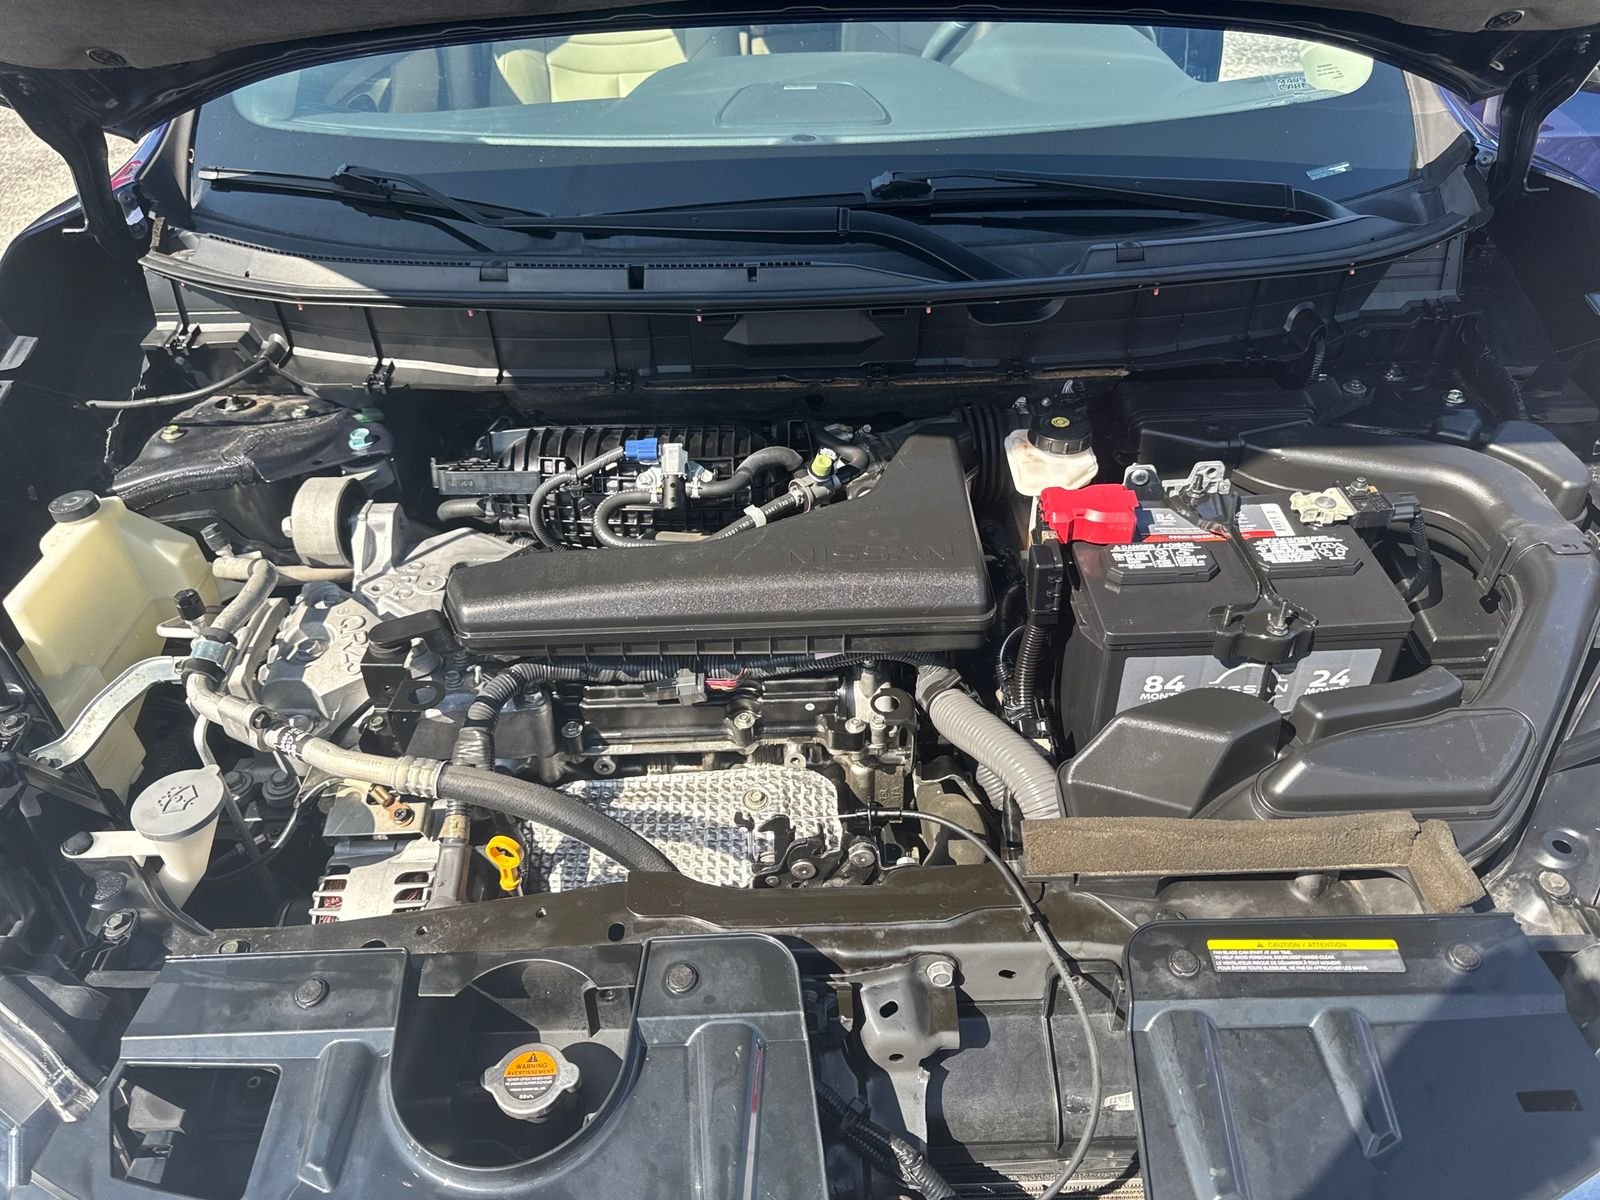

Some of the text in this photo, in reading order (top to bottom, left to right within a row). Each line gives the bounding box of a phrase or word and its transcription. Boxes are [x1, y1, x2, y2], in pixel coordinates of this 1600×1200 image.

[790, 545, 956, 563] NISSAN
[1143, 675, 1186, 692] 84
[1309, 669, 1351, 687] 24
[1140, 692, 1179, 700] MON
